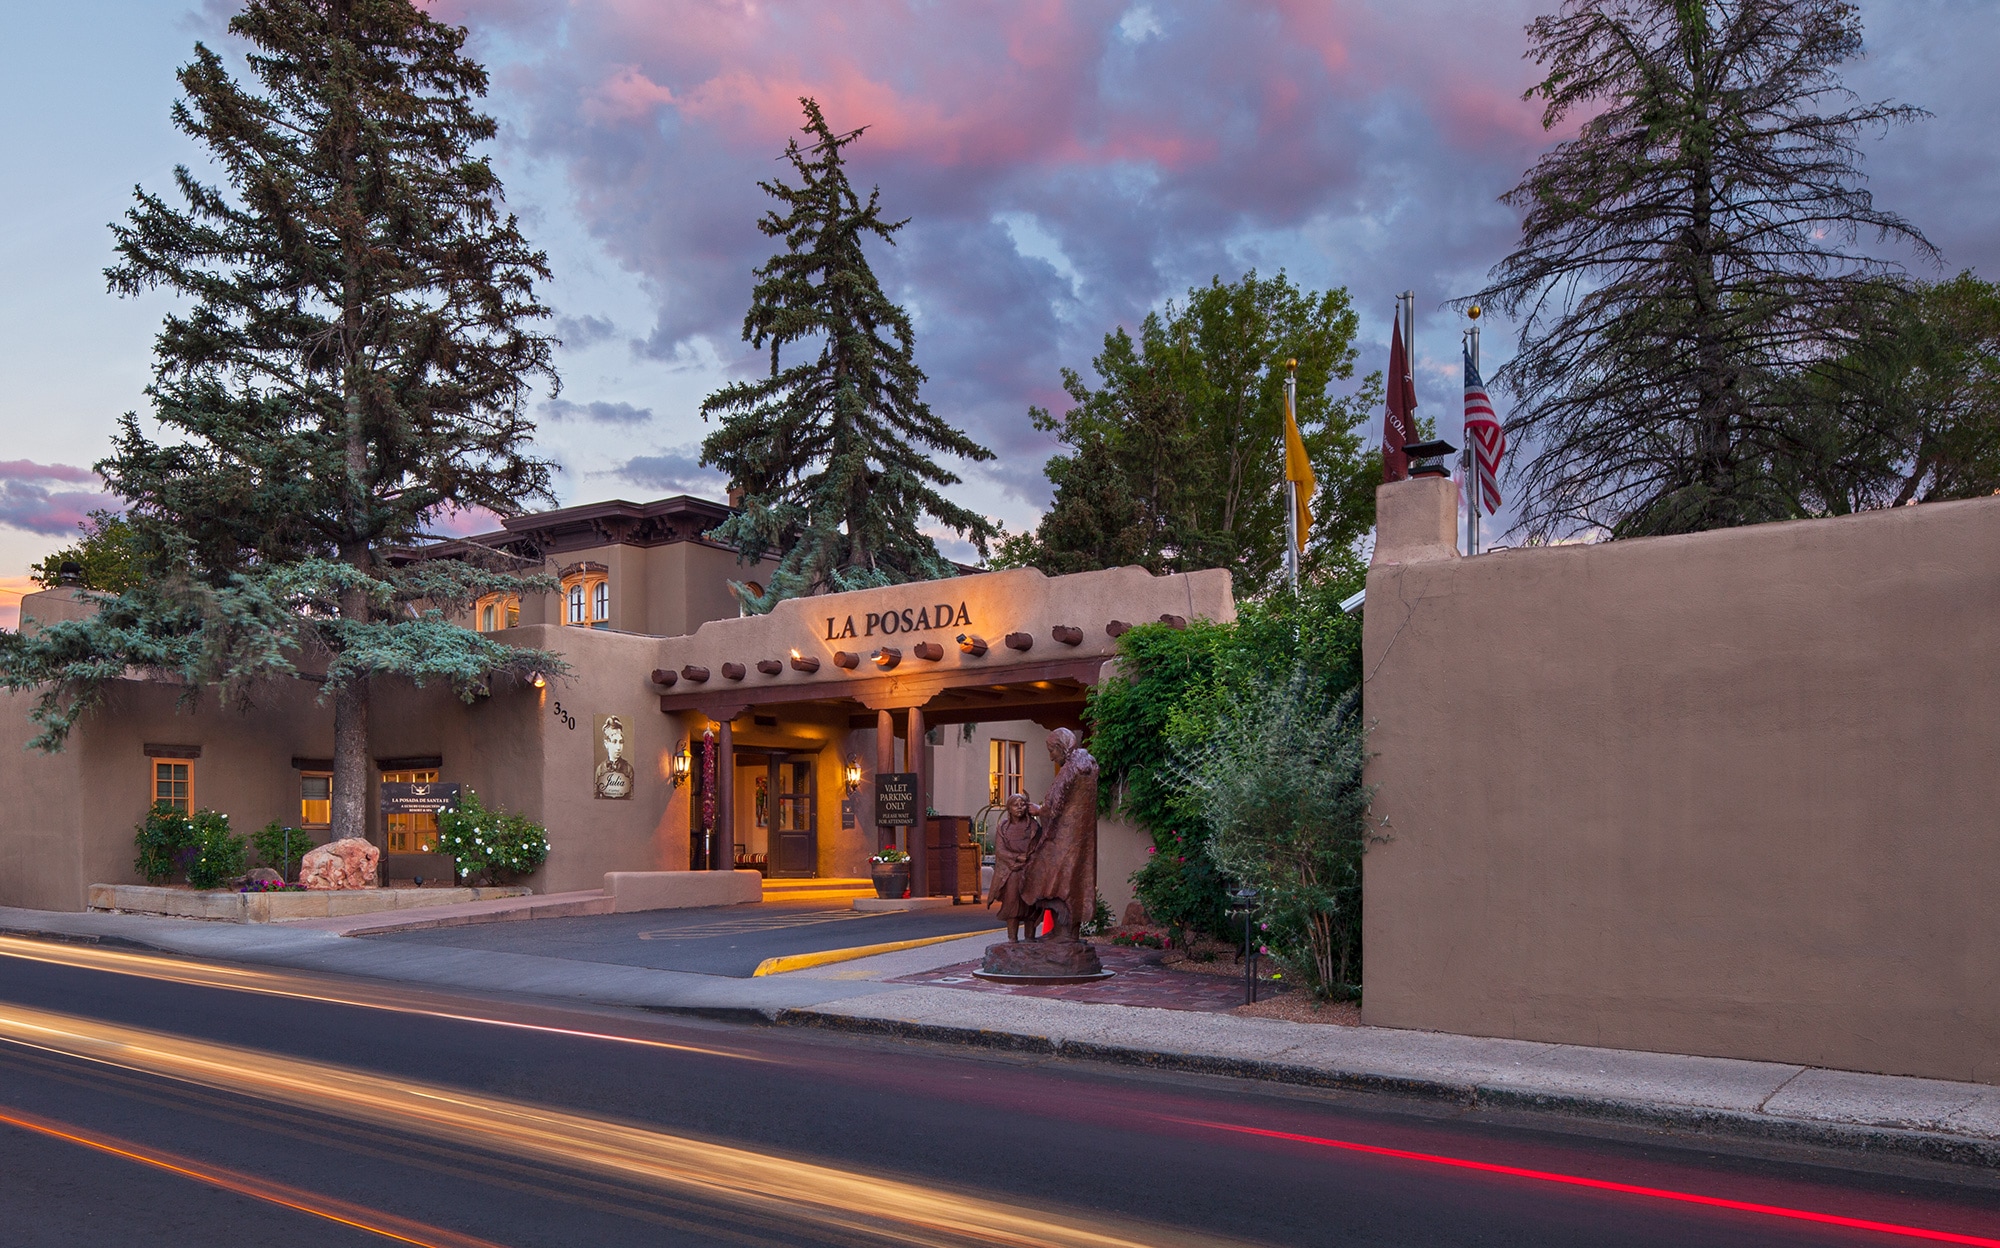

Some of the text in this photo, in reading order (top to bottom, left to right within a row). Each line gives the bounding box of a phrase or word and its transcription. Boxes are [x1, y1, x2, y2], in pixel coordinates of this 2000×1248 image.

[825, 601, 972, 641] LA POSADA
[553, 701, 576, 731] 330
[598, 773, 626, 791] Julia
[884, 784, 908, 792] VALET
[880, 793, 912, 801] PARKING
[885, 802, 906, 810] ONLY
